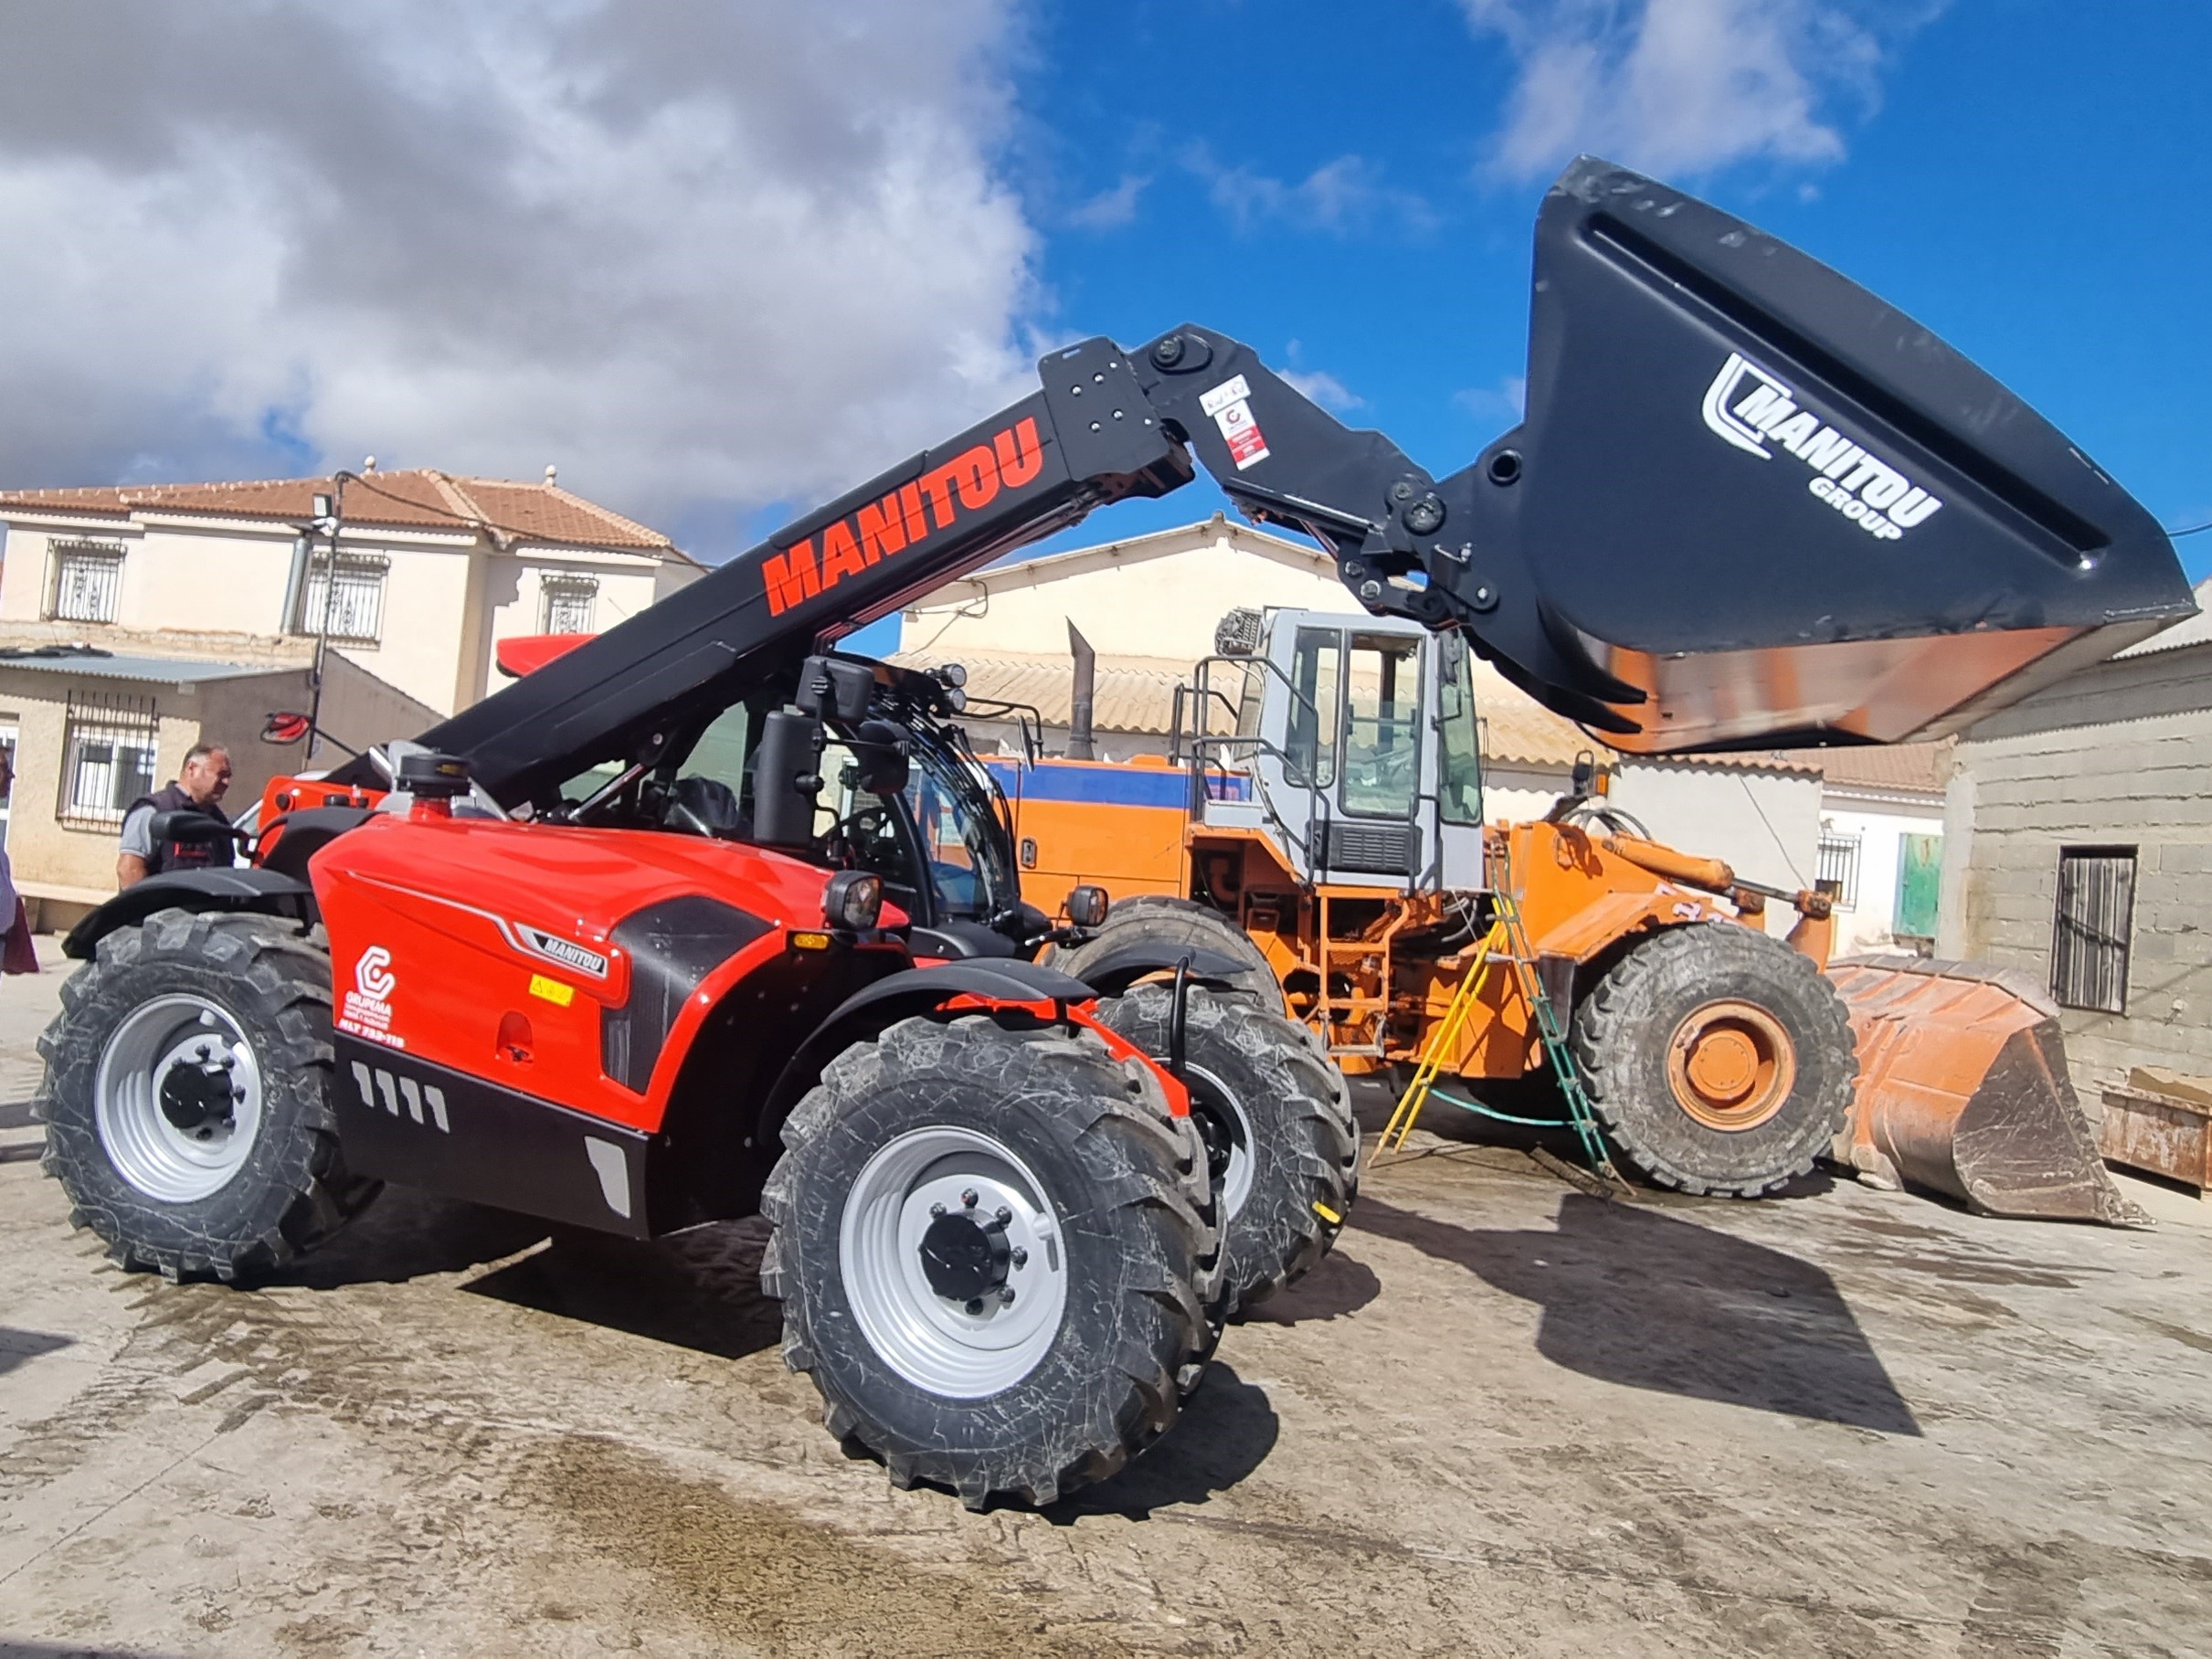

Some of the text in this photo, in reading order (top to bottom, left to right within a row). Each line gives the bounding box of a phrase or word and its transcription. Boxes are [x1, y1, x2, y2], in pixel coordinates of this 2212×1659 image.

[1733, 383, 1943, 528] MANITOU
[1809, 476, 1903, 539] GROUP
[762, 416, 1043, 618] MANITOU
[544, 938, 602, 970] MANITOU
